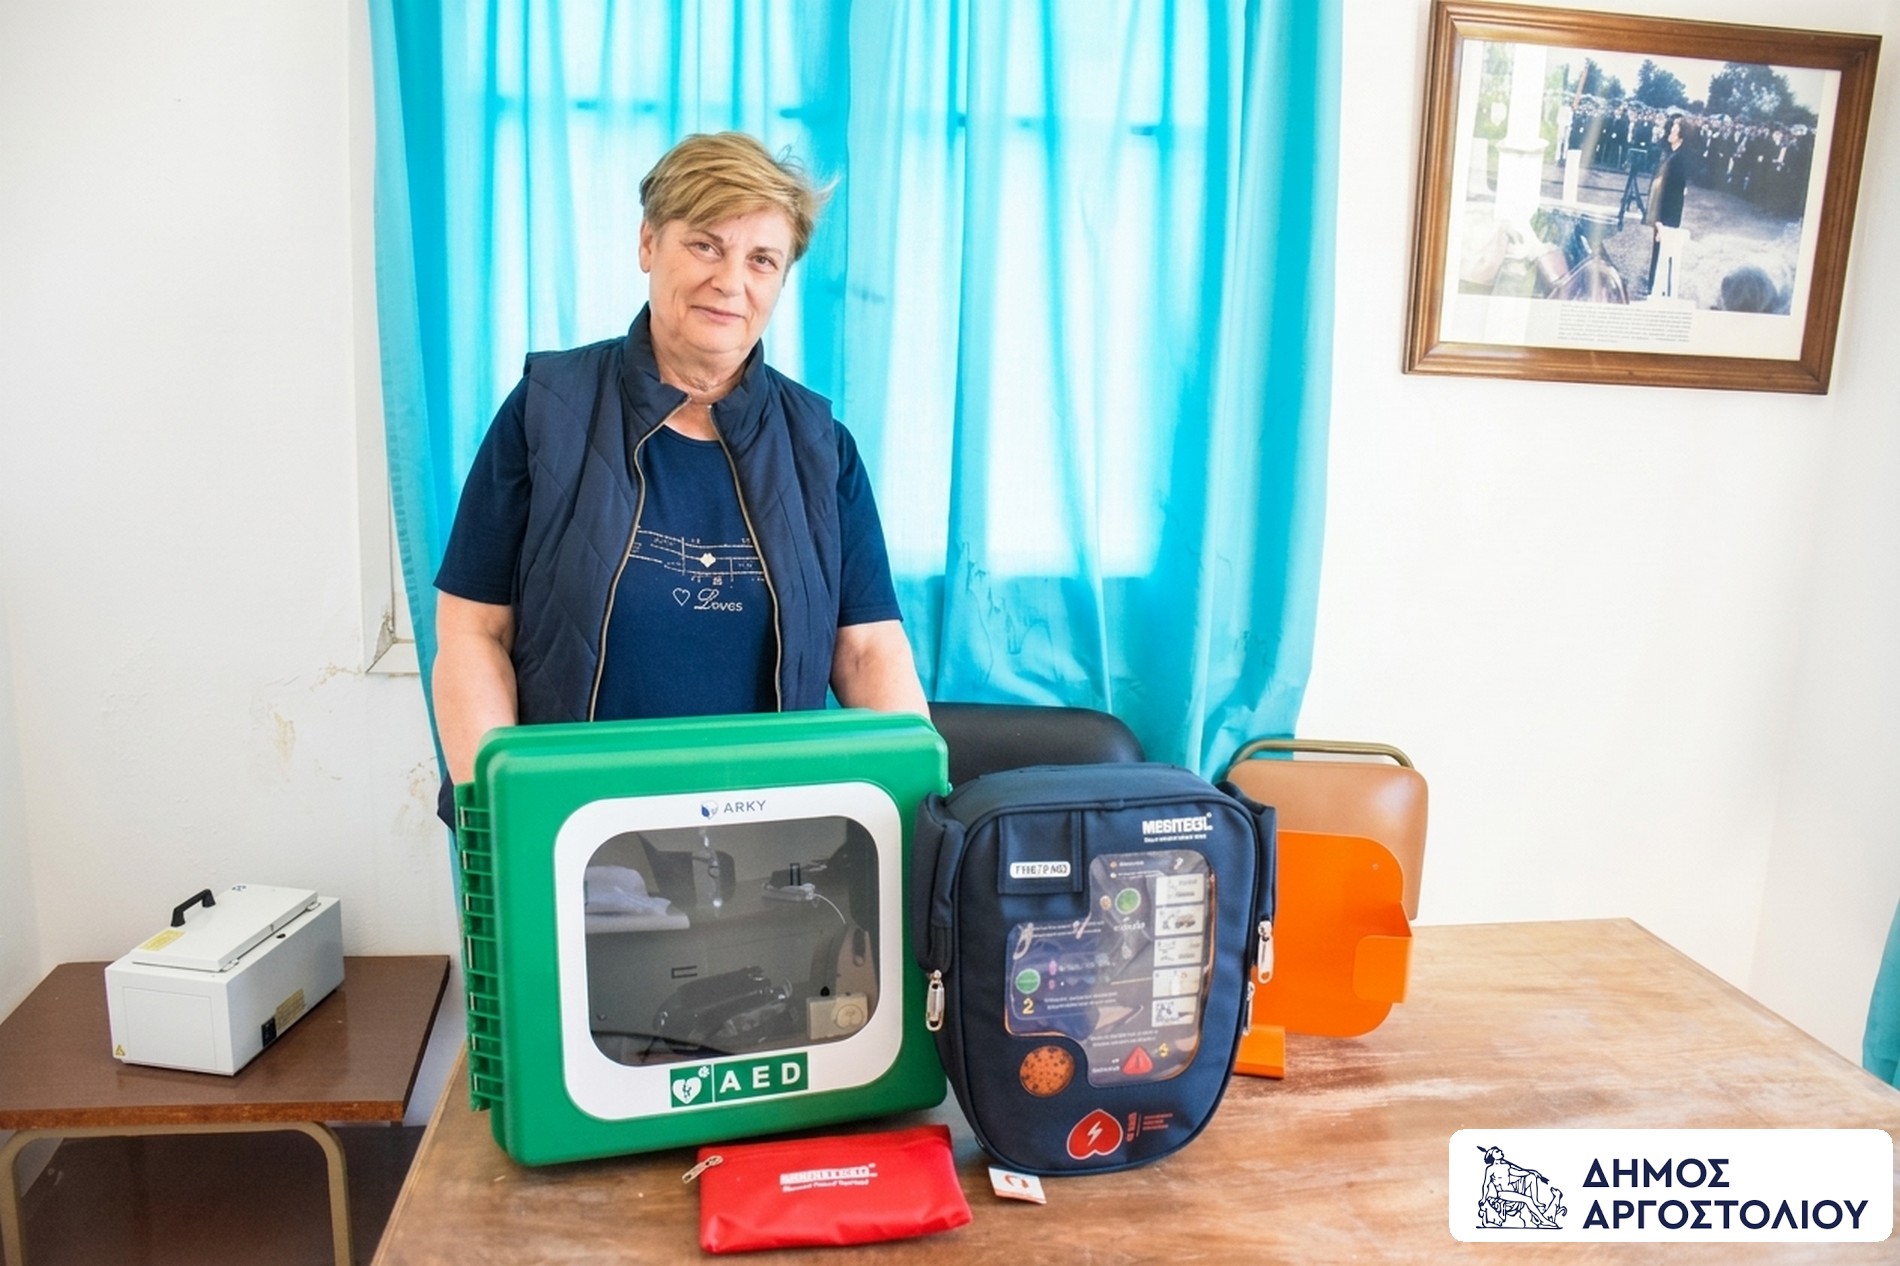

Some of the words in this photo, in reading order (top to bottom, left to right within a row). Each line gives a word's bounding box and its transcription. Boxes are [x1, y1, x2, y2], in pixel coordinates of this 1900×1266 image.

[693, 587, 744, 612] Loves
[723, 799, 767, 814] ARKY
[1022, 997, 1035, 1015] 2
[719, 1061, 801, 1094] AED
